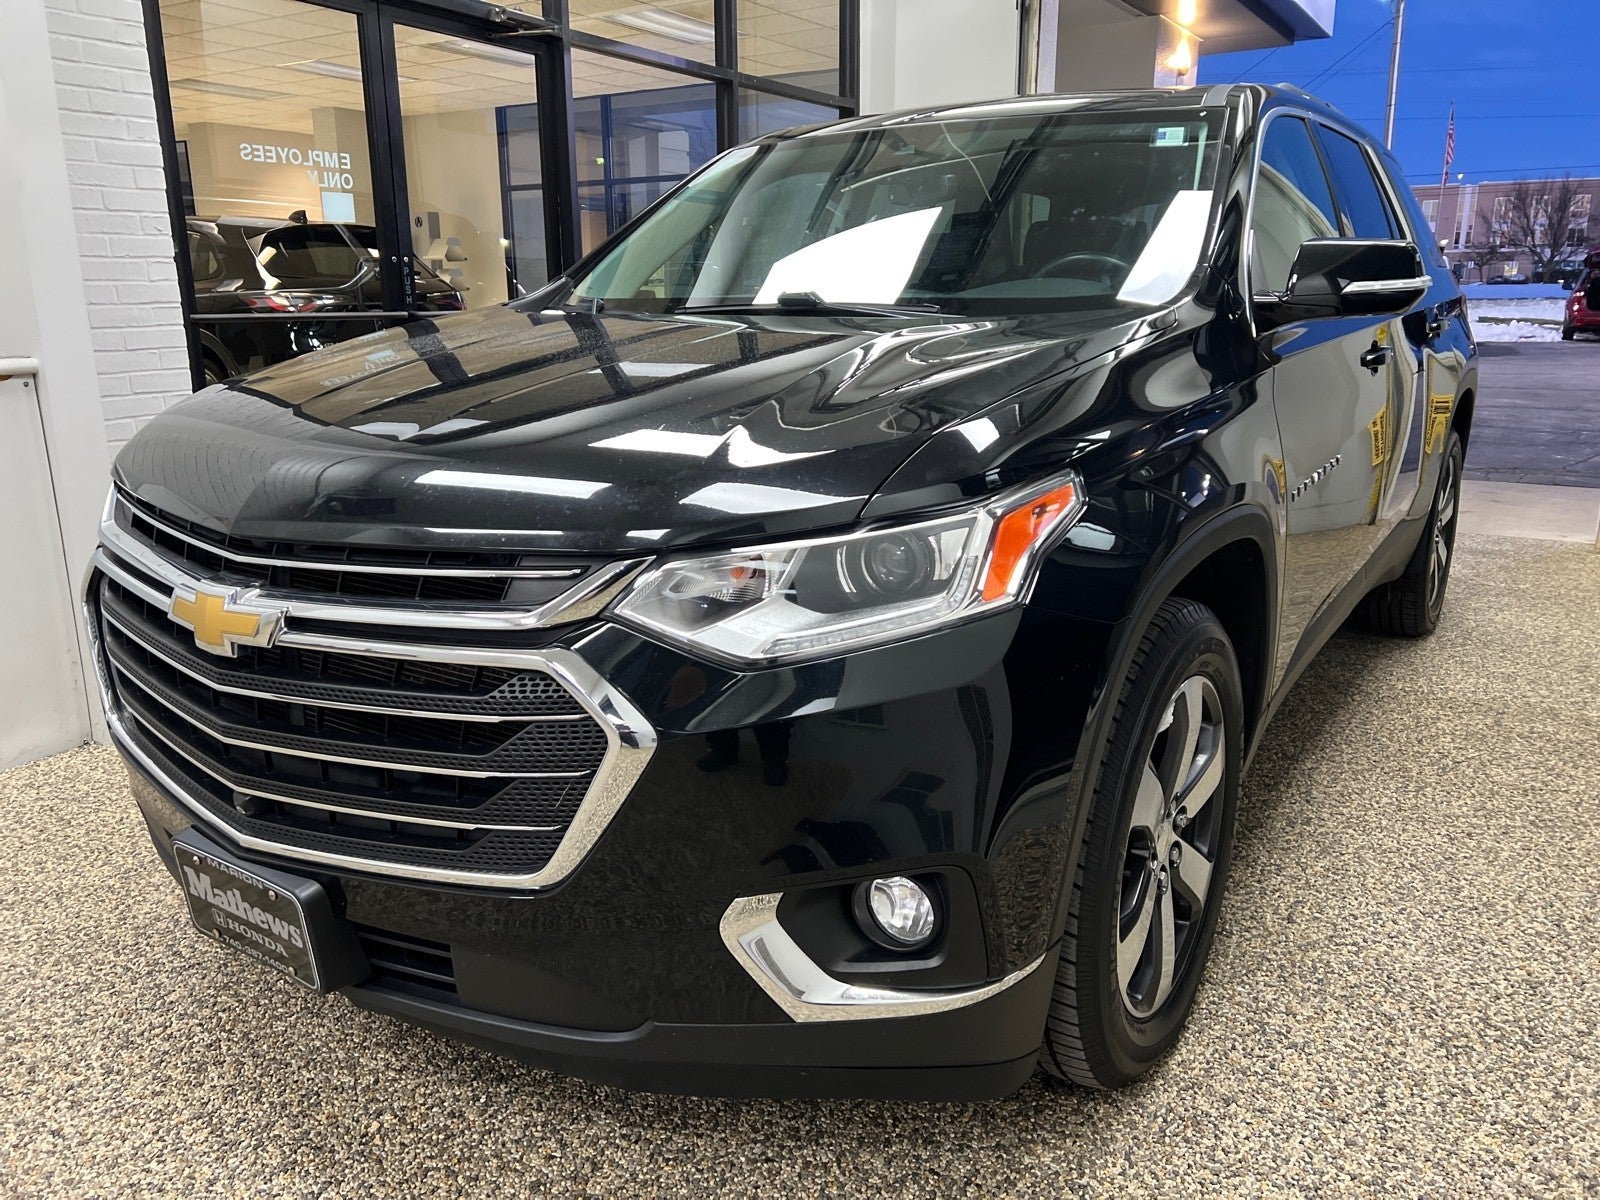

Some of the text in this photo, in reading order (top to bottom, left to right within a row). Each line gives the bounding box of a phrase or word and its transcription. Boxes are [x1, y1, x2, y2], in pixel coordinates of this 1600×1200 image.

[403, 266, 413, 304] PUSH
[206, 857, 264, 890] MARION
[183, 864, 304, 949] Mathews
[227, 917, 289, 958] HONDA
